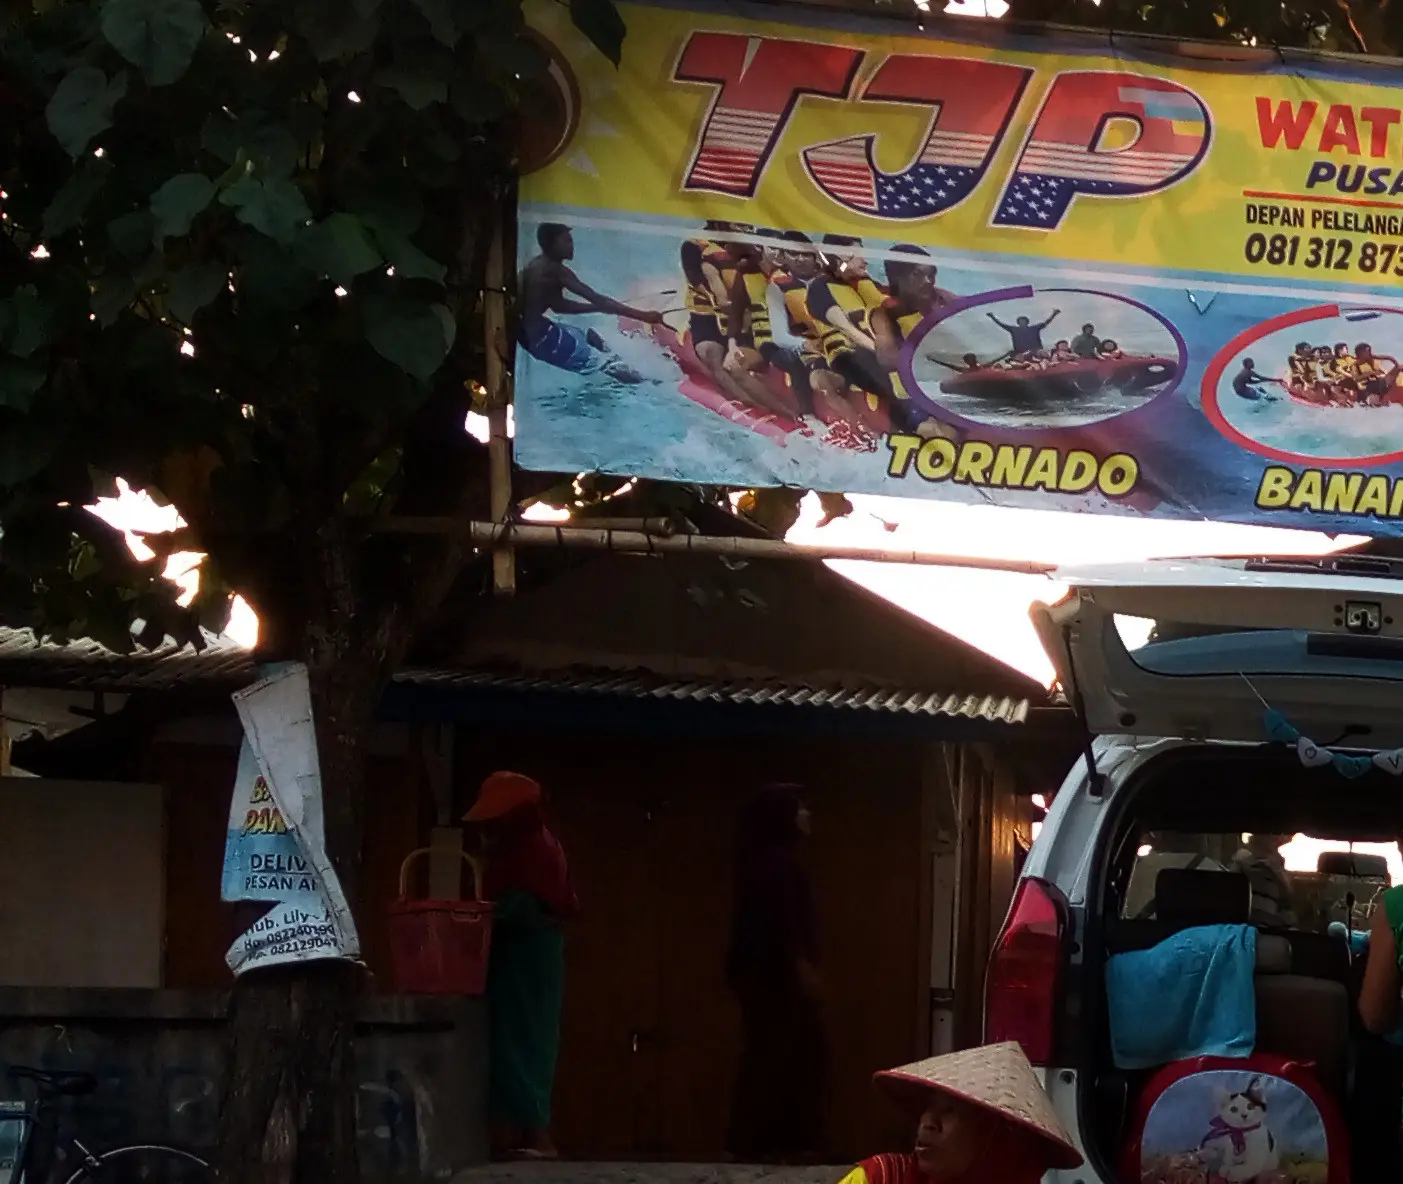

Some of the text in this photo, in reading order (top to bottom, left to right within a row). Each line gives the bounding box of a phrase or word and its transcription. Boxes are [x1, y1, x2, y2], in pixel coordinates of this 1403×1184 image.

[672, 29, 1214, 231] TJP
[1246, 203, 1304, 228] DEPAN
[1245, 231, 1299, 266] 081
[1305, 236, 1350, 269] 312
[886, 432, 1139, 498] TORNADO
[245, 875, 292, 891] PESAN
